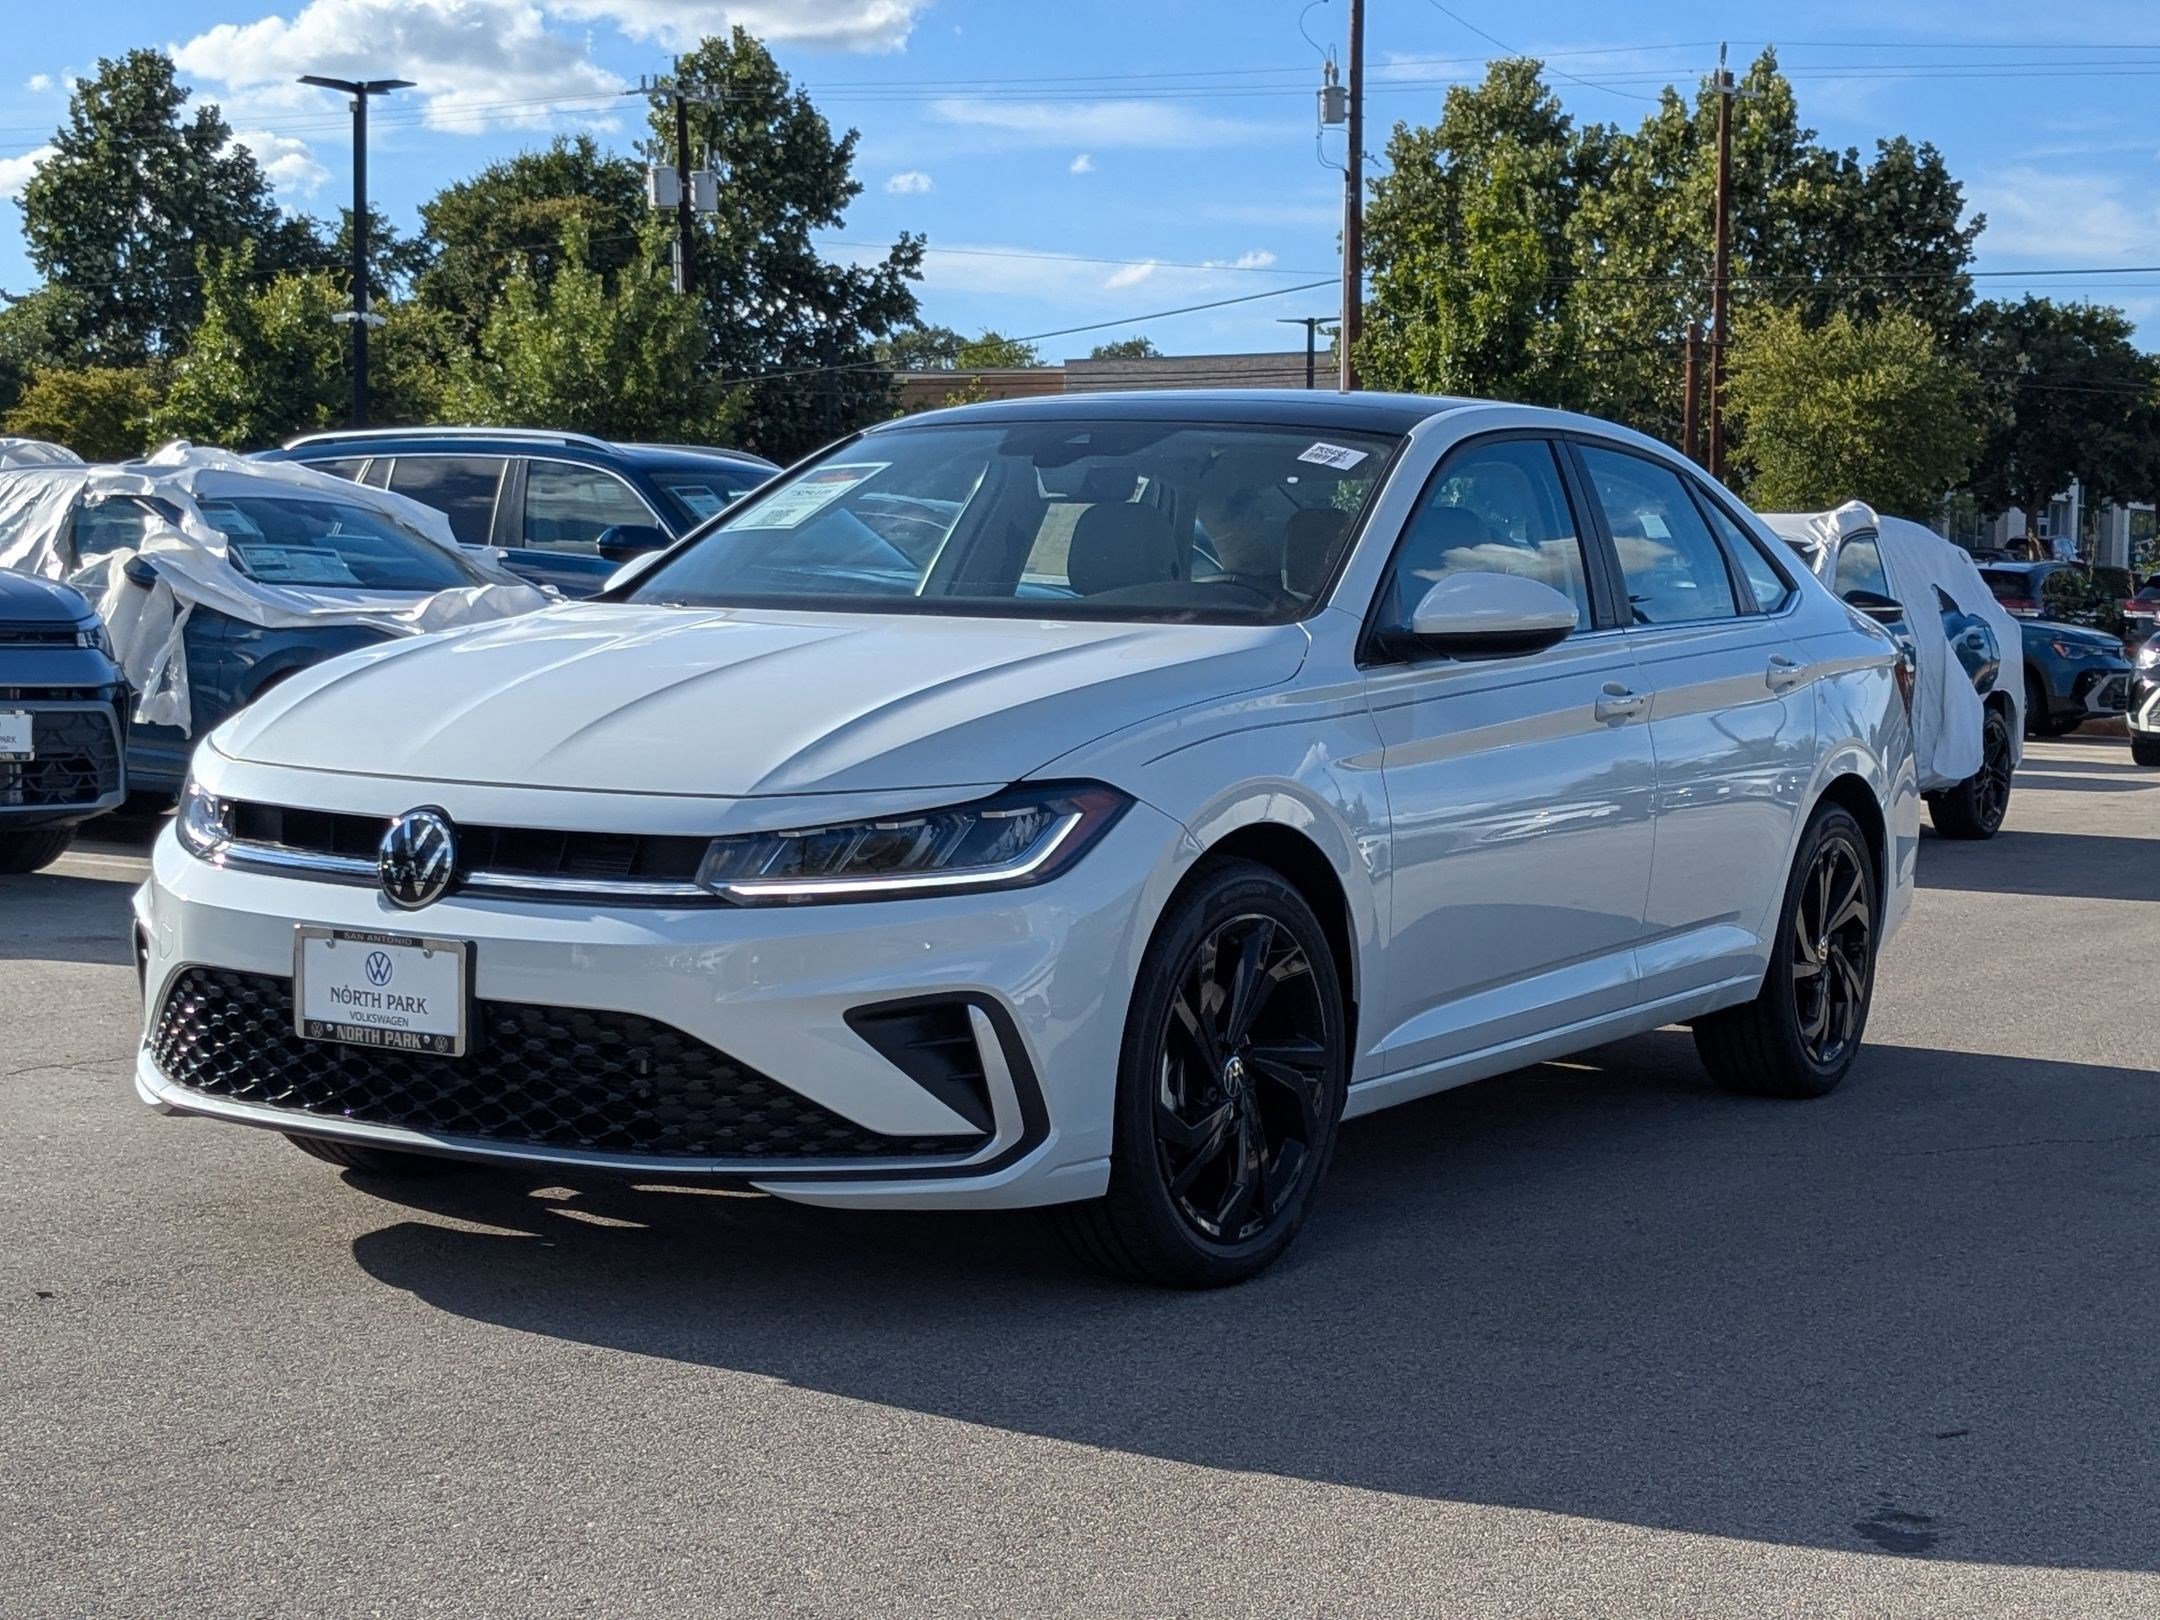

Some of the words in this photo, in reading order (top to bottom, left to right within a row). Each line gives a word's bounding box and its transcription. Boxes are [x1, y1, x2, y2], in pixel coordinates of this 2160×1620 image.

[344, 931, 365, 941] SAN
[366, 934, 413, 946] ANTONIO
[330, 985, 382, 1009] NORTH
[386, 993, 429, 1015] PARK
[349, 1010, 409, 1027] VOLKSWAGEN
[336, 1024, 381, 1044] NORTH
[384, 1029, 422, 1049] PARK
